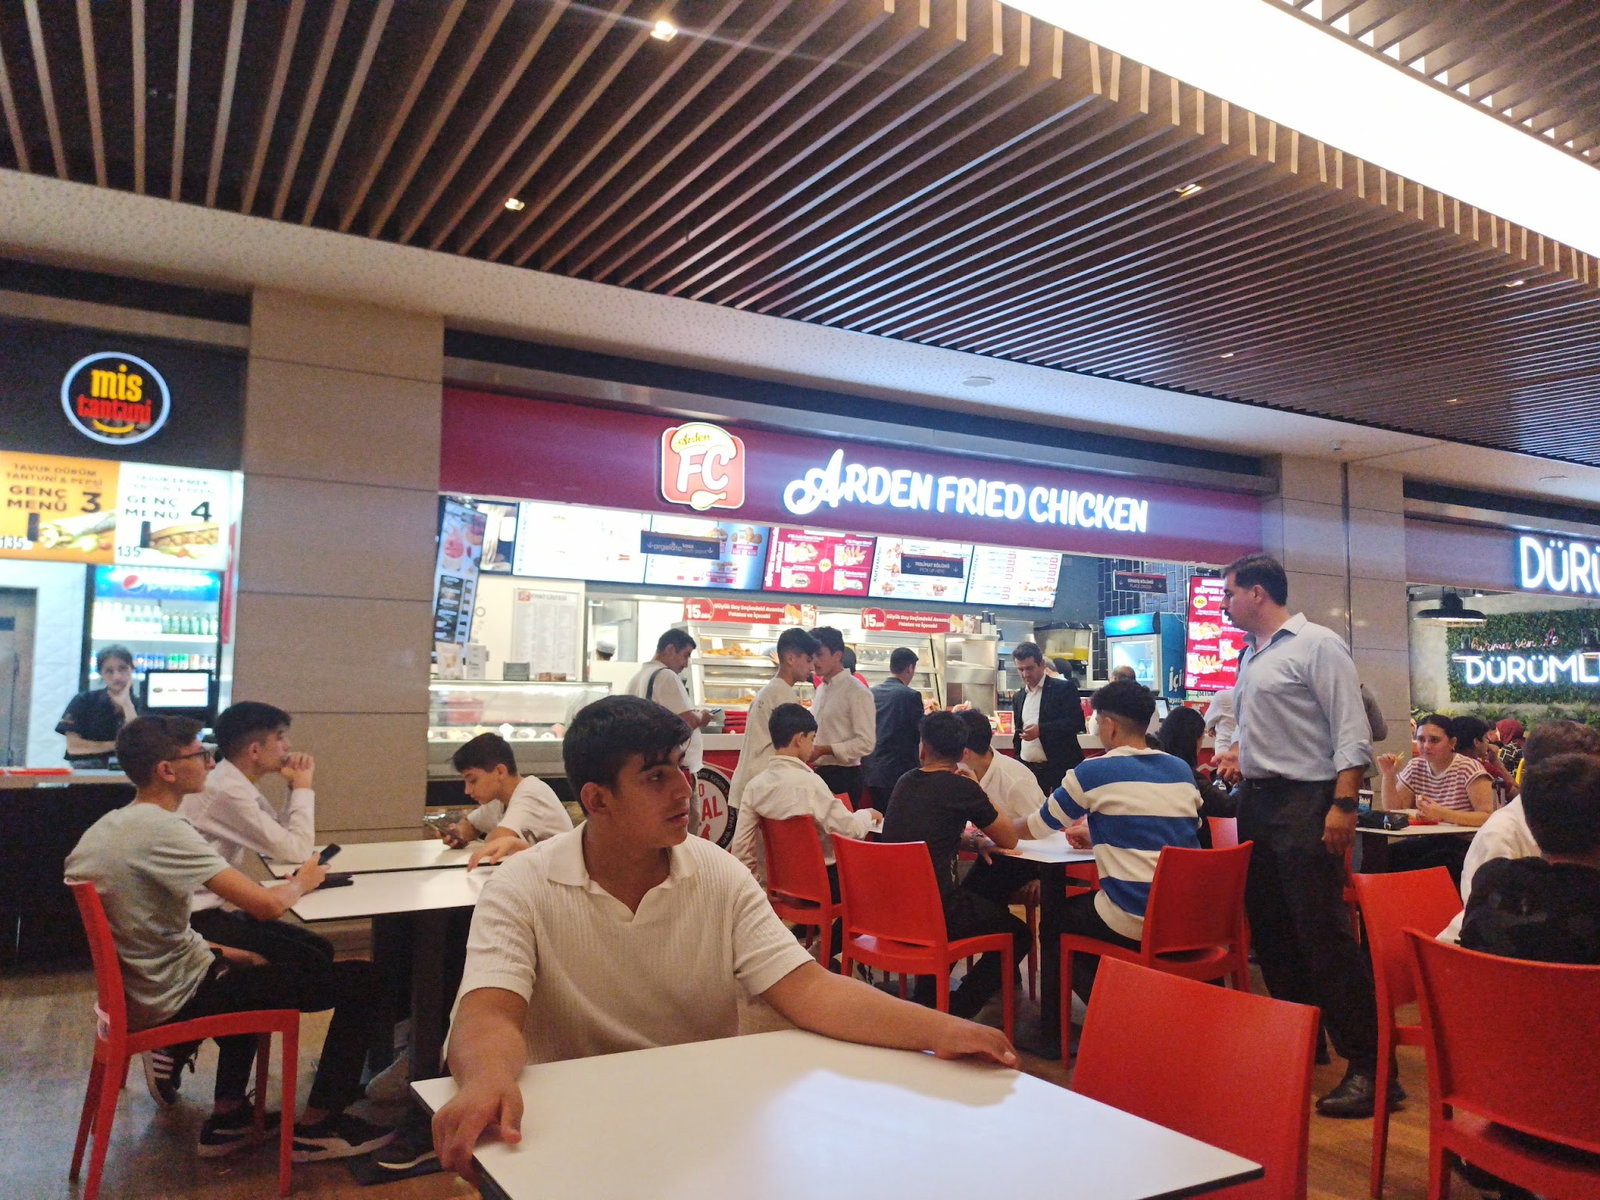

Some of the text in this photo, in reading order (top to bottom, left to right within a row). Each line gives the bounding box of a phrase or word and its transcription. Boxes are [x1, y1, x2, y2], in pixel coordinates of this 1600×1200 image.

[91, 364, 143, 402] mis
[77, 394, 152, 424] tantuni
[13, 463, 97, 477] TAVUK DÜRÜM
[676, 445, 729, 493] FC
[9, 485, 68, 500] GENÇ
[80, 491, 103, 513] 3
[783, 449, 1149, 533] ARDEN FRIED CHICKEN
[7, 498, 68, 513] MENÜ
[190, 501, 213, 523] 4
[117, 546, 142, 558] 135
[1466, 654, 1600, 684] DÜRÜML
